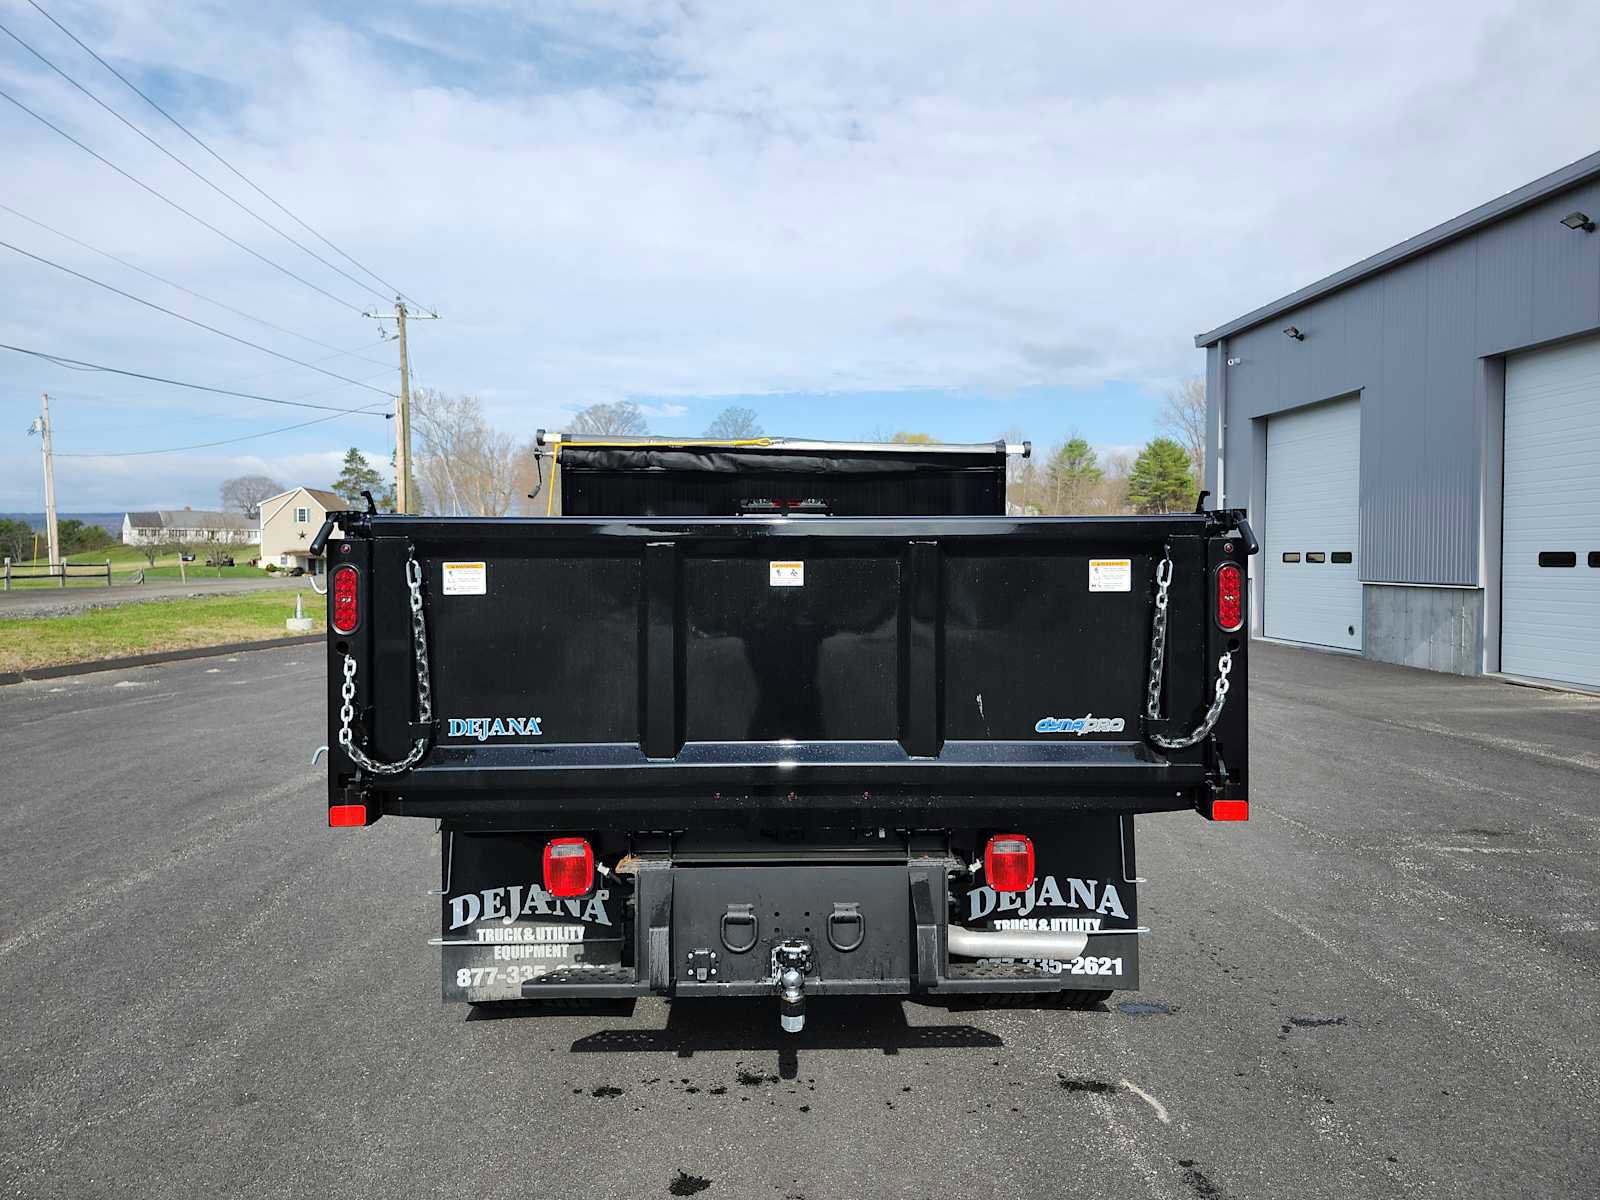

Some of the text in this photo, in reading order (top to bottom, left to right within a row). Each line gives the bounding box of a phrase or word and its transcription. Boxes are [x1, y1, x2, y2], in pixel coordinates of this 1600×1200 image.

[447, 717, 542, 741] DEJANA
[449, 883, 612, 930] DEJANA
[966, 875, 1129, 921] DEJANA
[494, 944, 569, 960] EQUIPMENT
